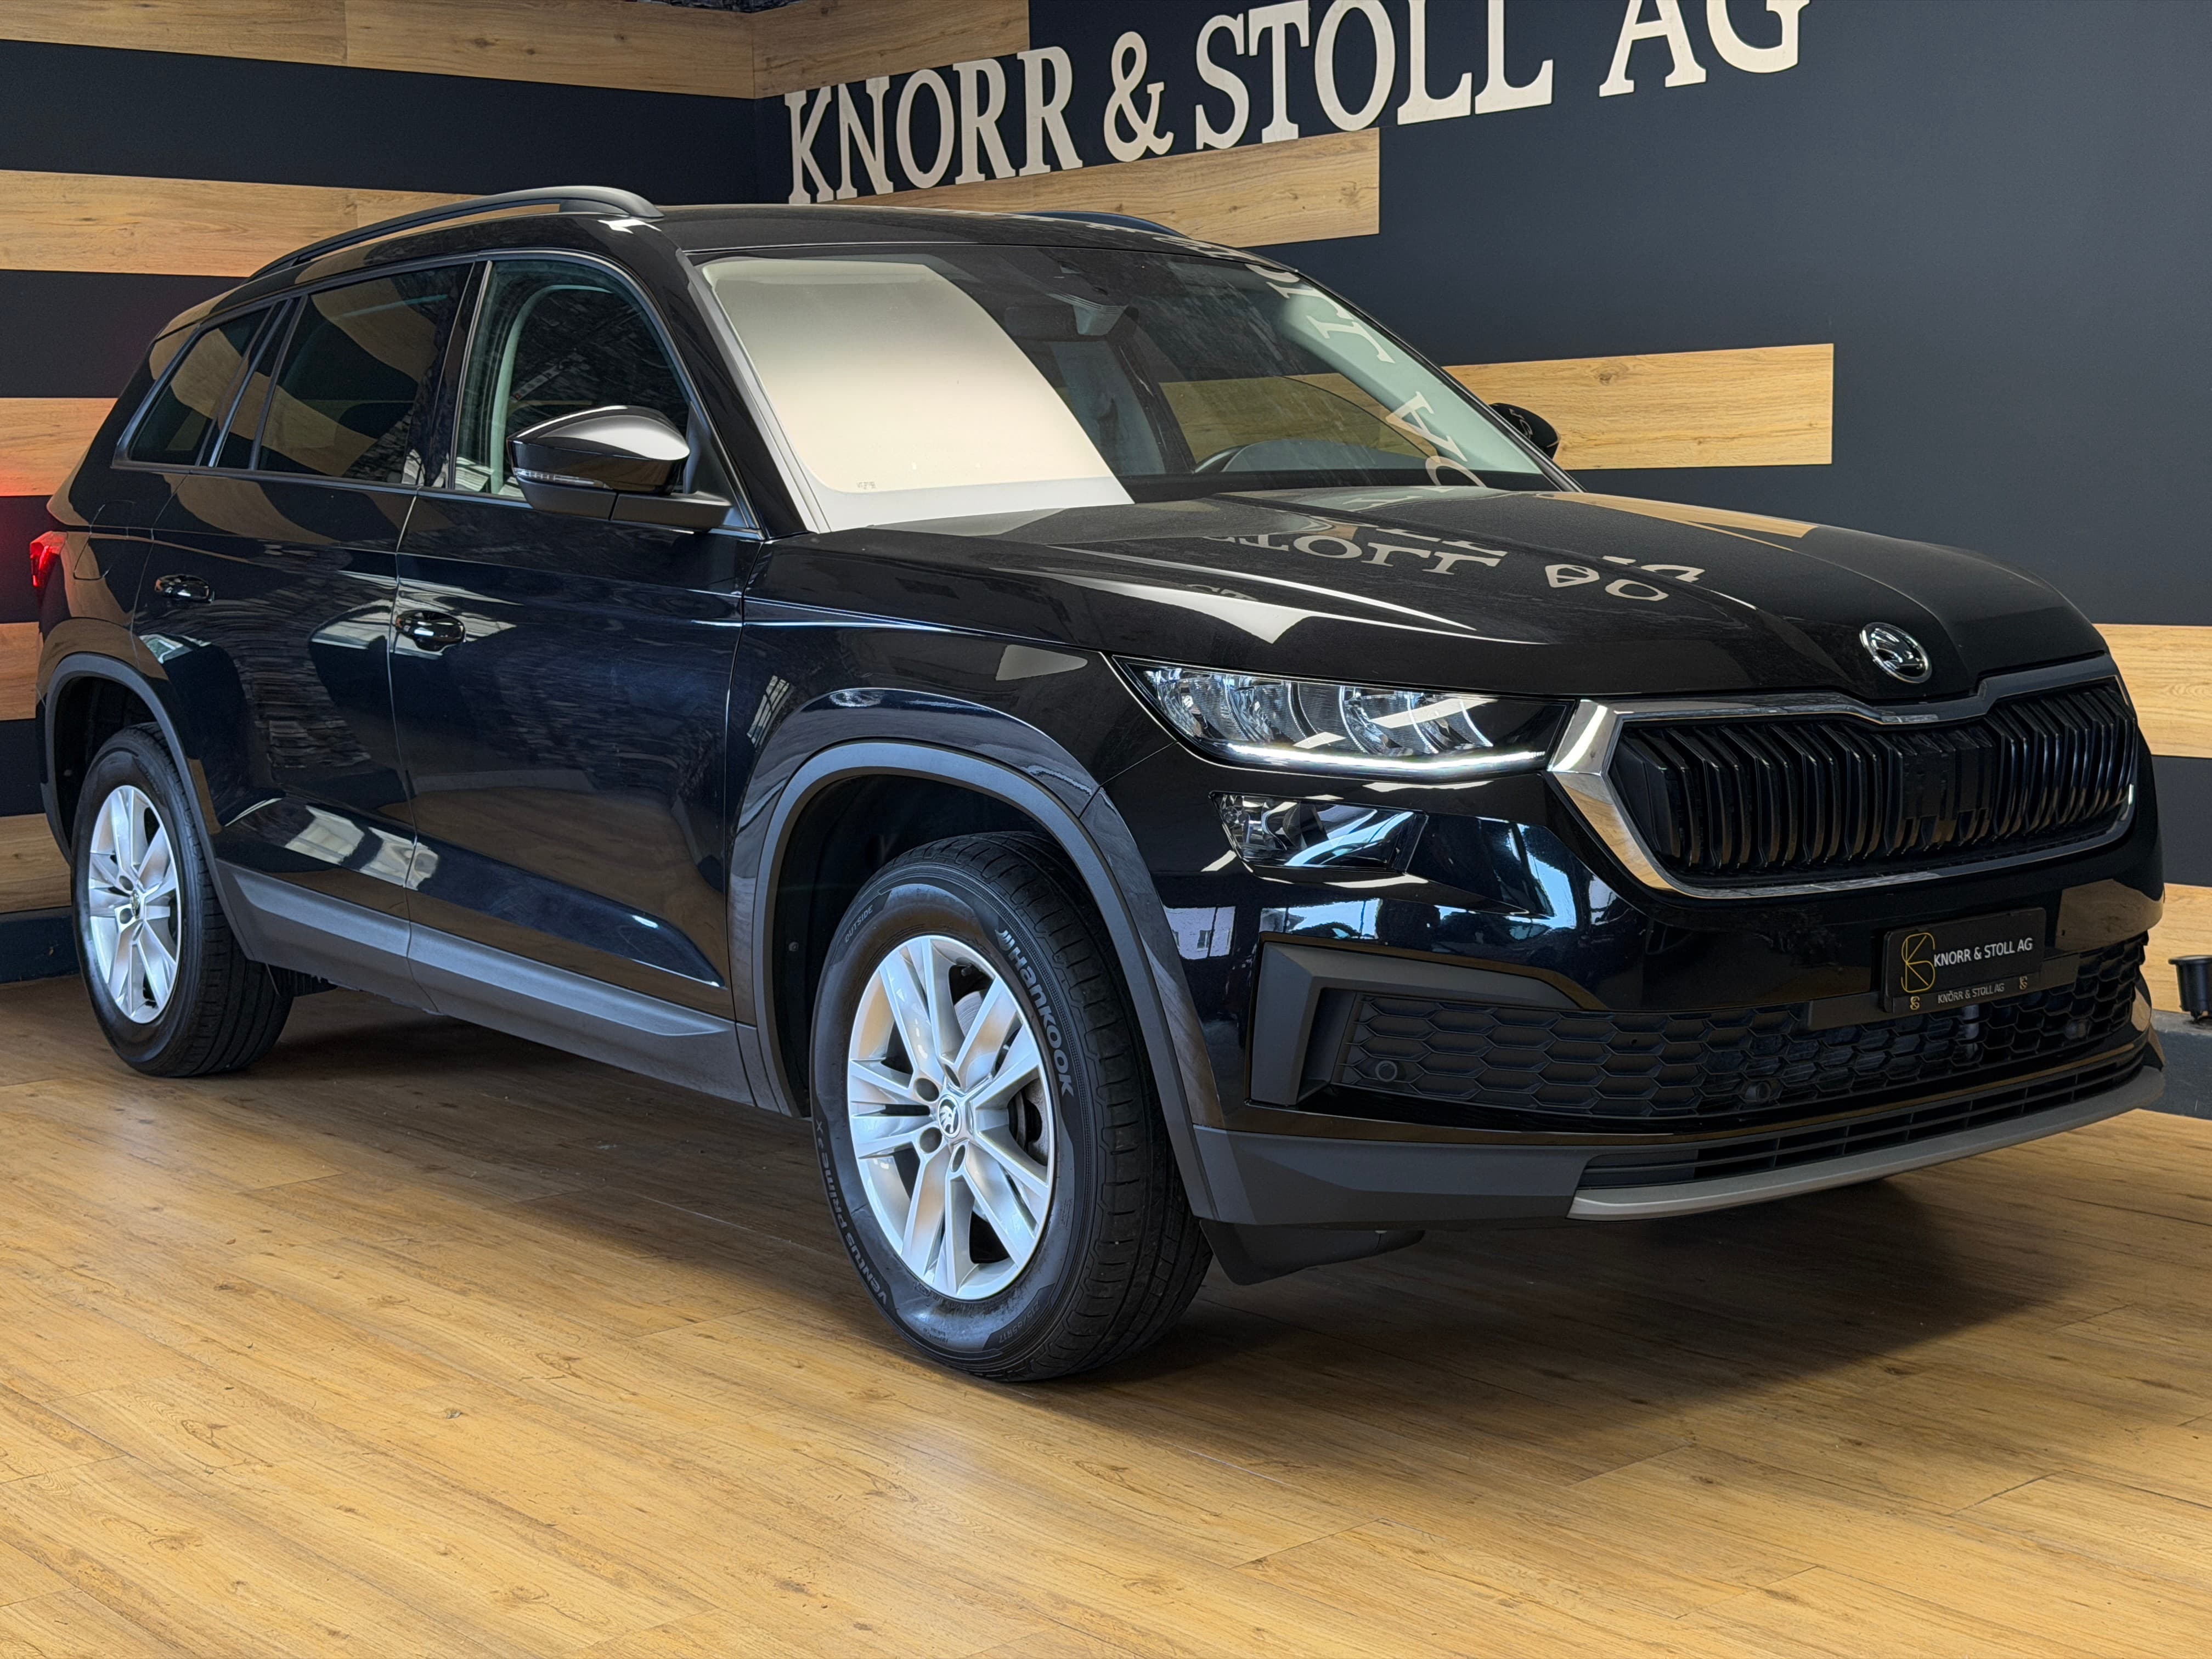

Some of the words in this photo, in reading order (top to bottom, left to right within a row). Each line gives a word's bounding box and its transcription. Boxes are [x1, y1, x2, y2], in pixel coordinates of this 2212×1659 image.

[784, 46, 1083, 204] KNORR
[1103, 31, 1175, 162] &
[1195, 0, 1553, 150] STOLL
[845, 905, 873, 943] OUTSIDE
[1934, 949, 1971, 967] KNORR
[1973, 946, 1982, 960] &
[1984, 940, 2015, 958] STOLL
[2017, 937, 2033, 952] AG
[1965, 990, 1971, 998] &
[1972, 985, 1994, 998] STOLL
[1994, 983, 2005, 993] AG
